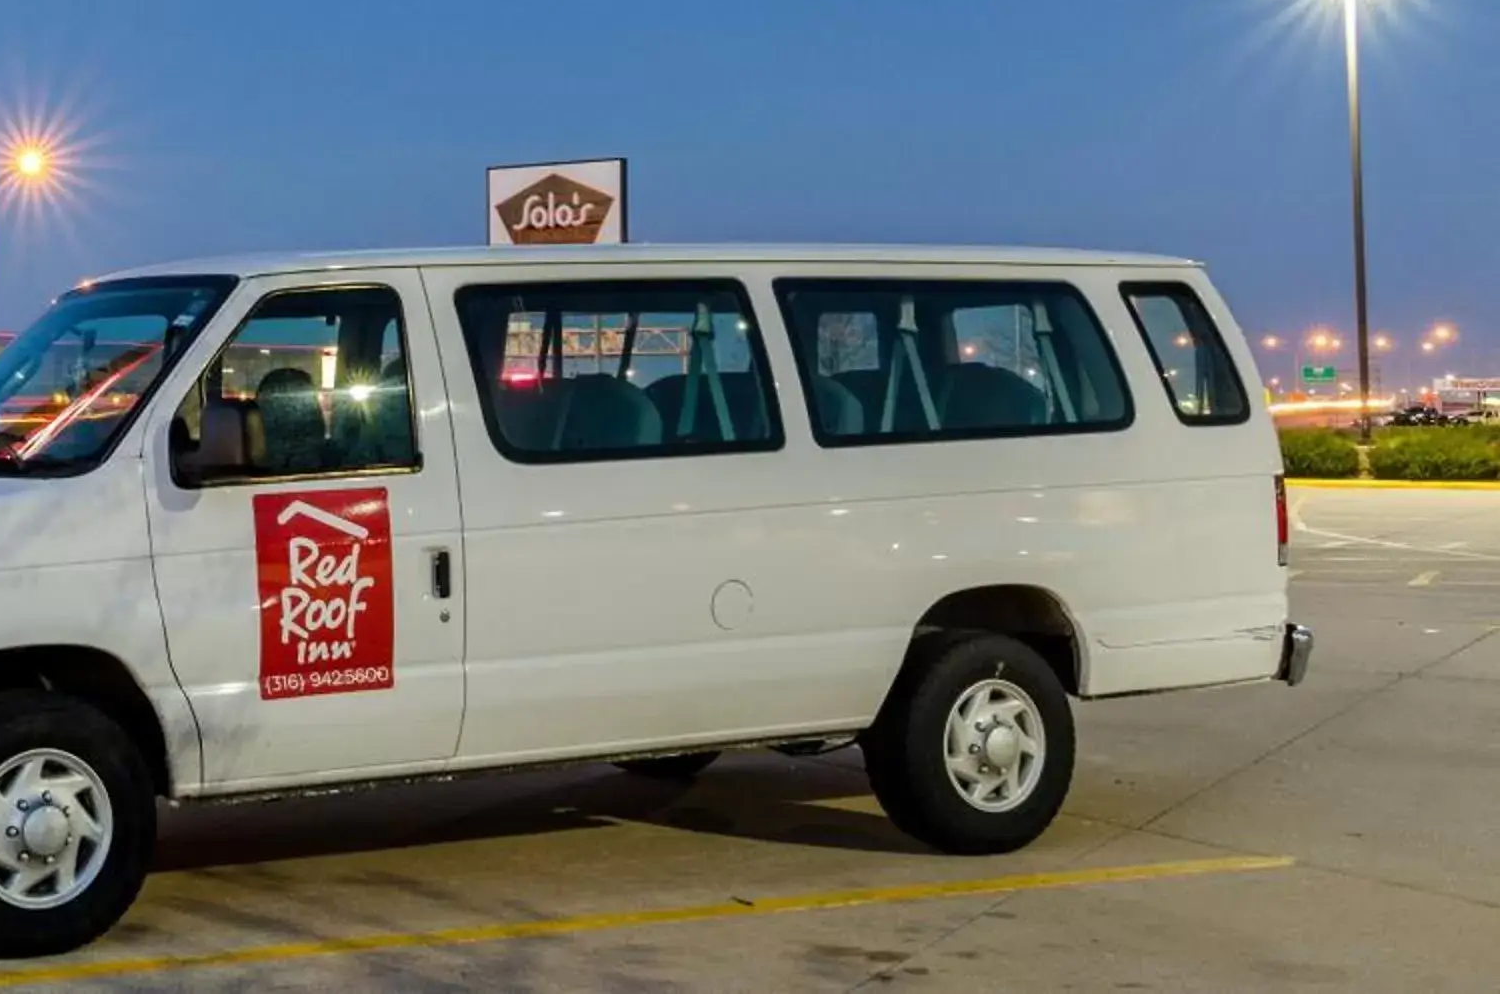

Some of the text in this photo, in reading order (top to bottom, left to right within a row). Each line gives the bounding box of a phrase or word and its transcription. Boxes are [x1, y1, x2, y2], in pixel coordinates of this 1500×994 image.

[512, 191, 595, 231] Solo's
[289, 537, 361, 589] Red
[280, 577, 375, 644] Roof
[265, 673, 306, 695] (316)
